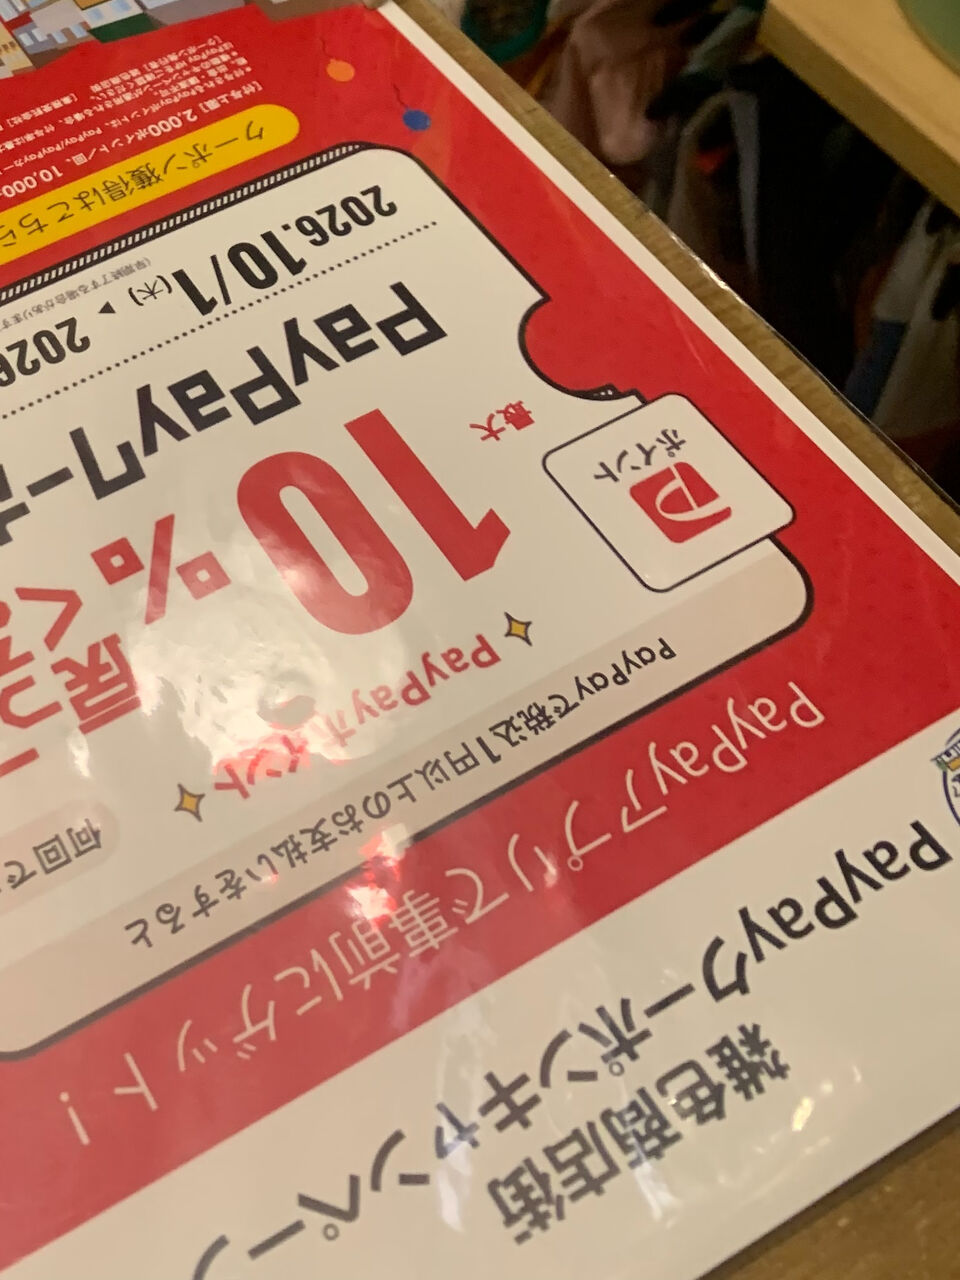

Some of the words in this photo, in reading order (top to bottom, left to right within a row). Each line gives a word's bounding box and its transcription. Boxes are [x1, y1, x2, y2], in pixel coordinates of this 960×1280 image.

[469, 400, 535, 441] 最大
[593, 428, 686, 483] ポイント
[59, 662, 842, 1146] PayPayアプリで事前にゲット！
[124, 637, 677, 948] PayPayで税込1円以上のお支払いをすると
[482, 1020, 794, 1248] 雑色商店街
